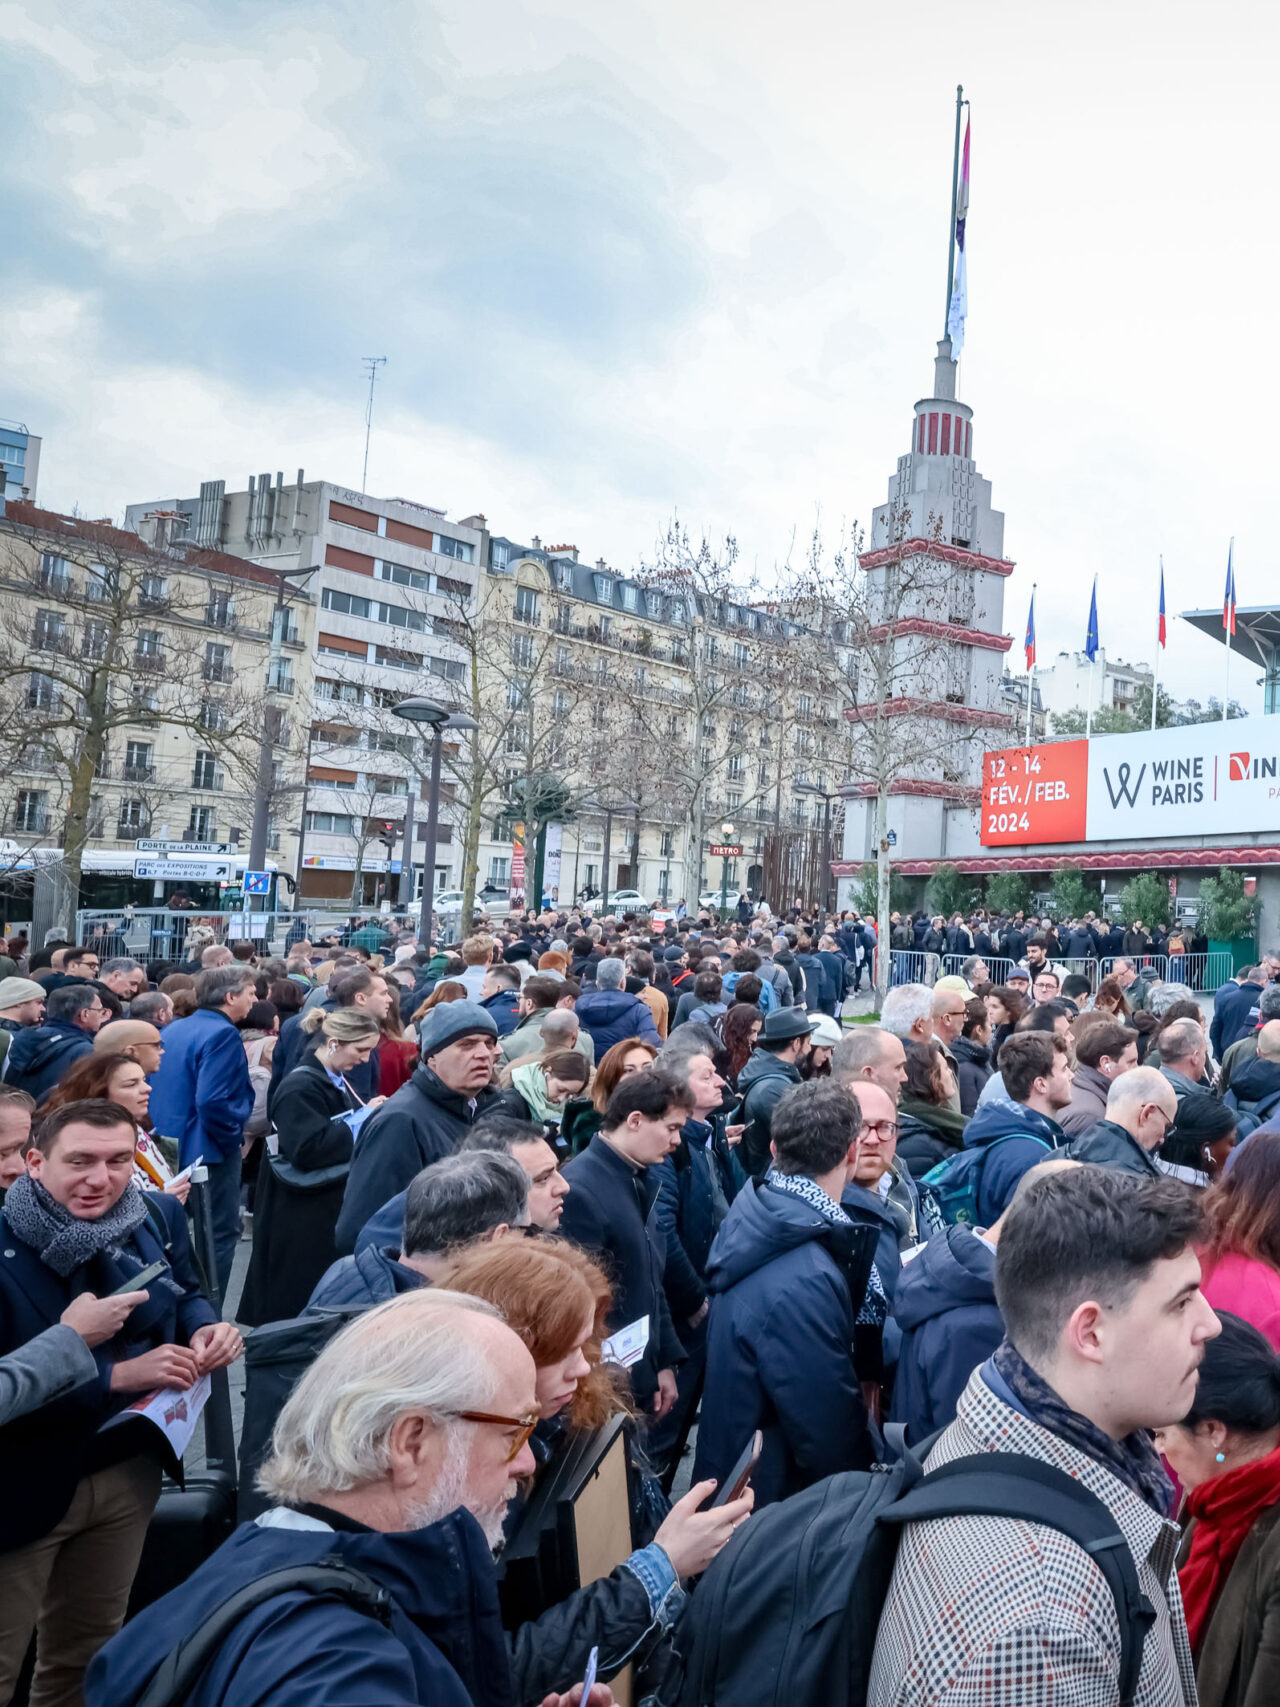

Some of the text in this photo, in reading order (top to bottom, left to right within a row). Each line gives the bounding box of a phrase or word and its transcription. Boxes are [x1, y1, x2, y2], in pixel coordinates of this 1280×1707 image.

[990, 759, 1006, 778] 12
[1023, 755, 1042, 775] 14
[1152, 757, 1204, 782] WINE
[1152, 782, 1204, 806] PARIS
[988, 812, 1030, 833] 2024
